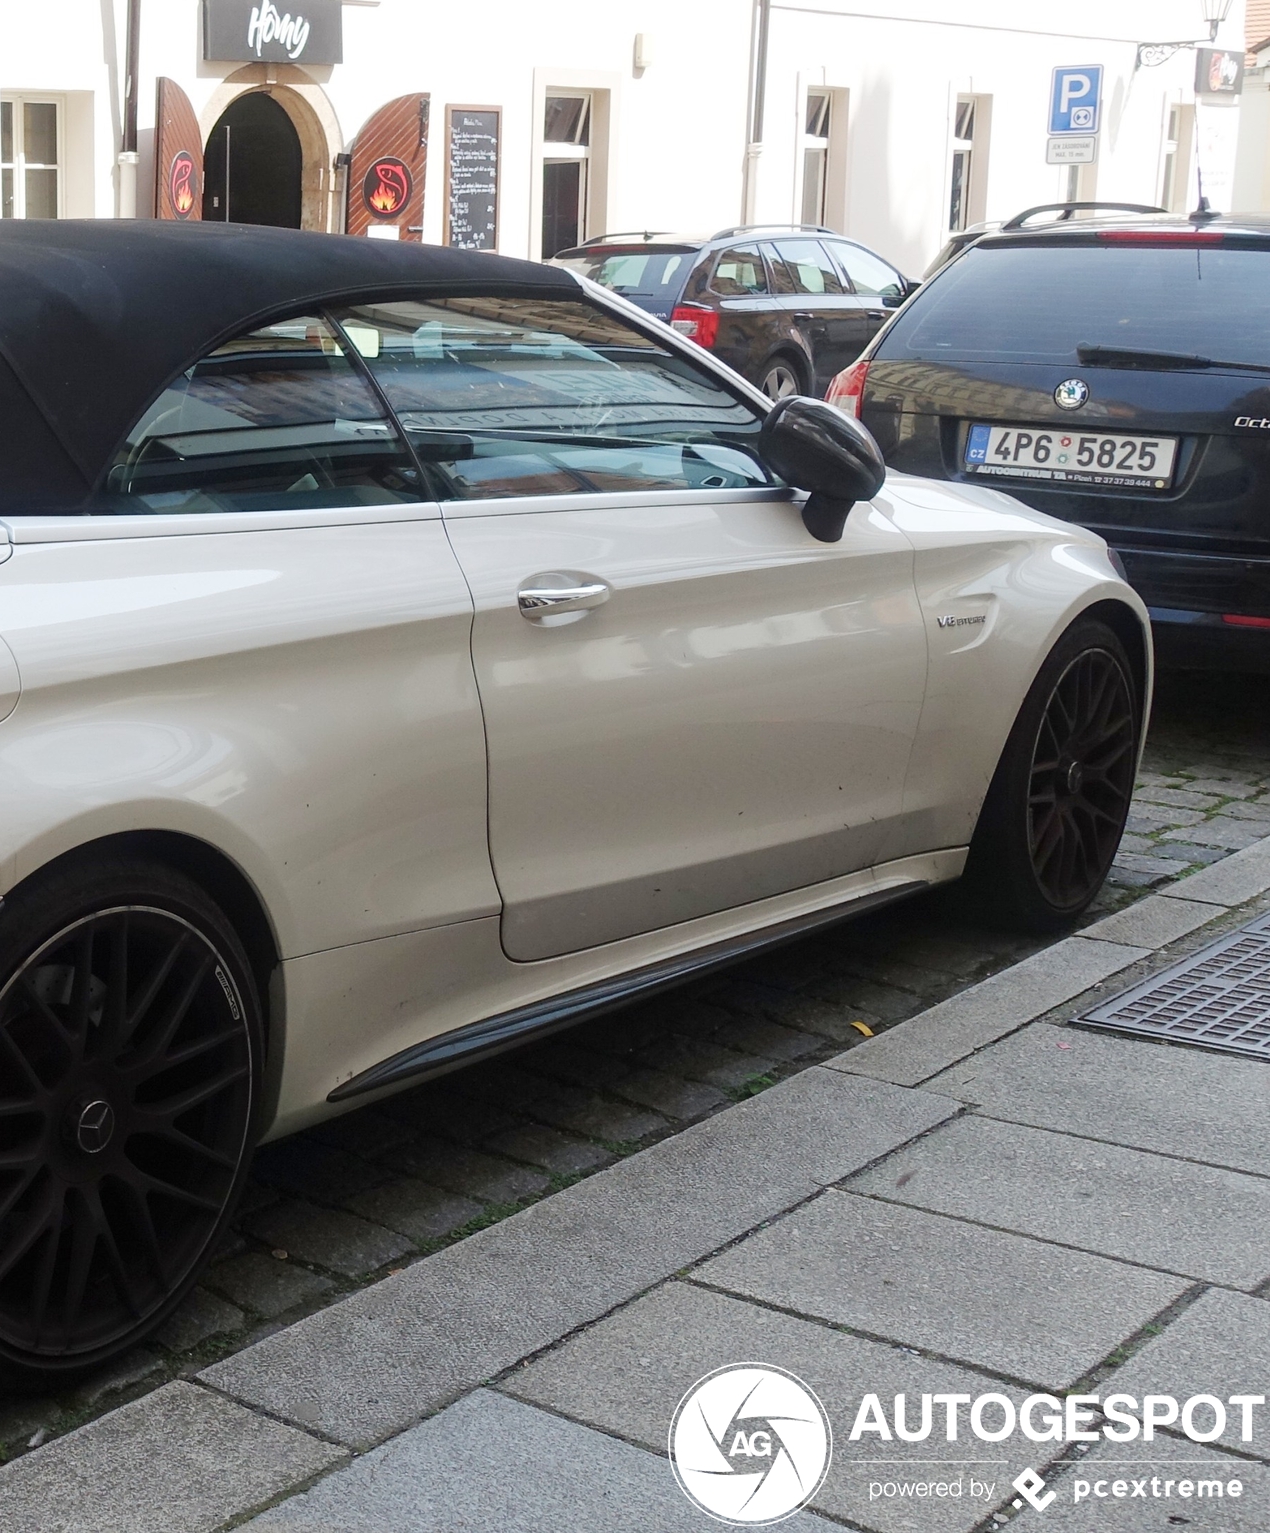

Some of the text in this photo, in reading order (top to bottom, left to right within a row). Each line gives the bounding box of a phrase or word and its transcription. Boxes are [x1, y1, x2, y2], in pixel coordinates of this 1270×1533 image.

[1059, 74, 1091, 113] P
[970, 431, 1159, 472] CZ 4P6 5825
